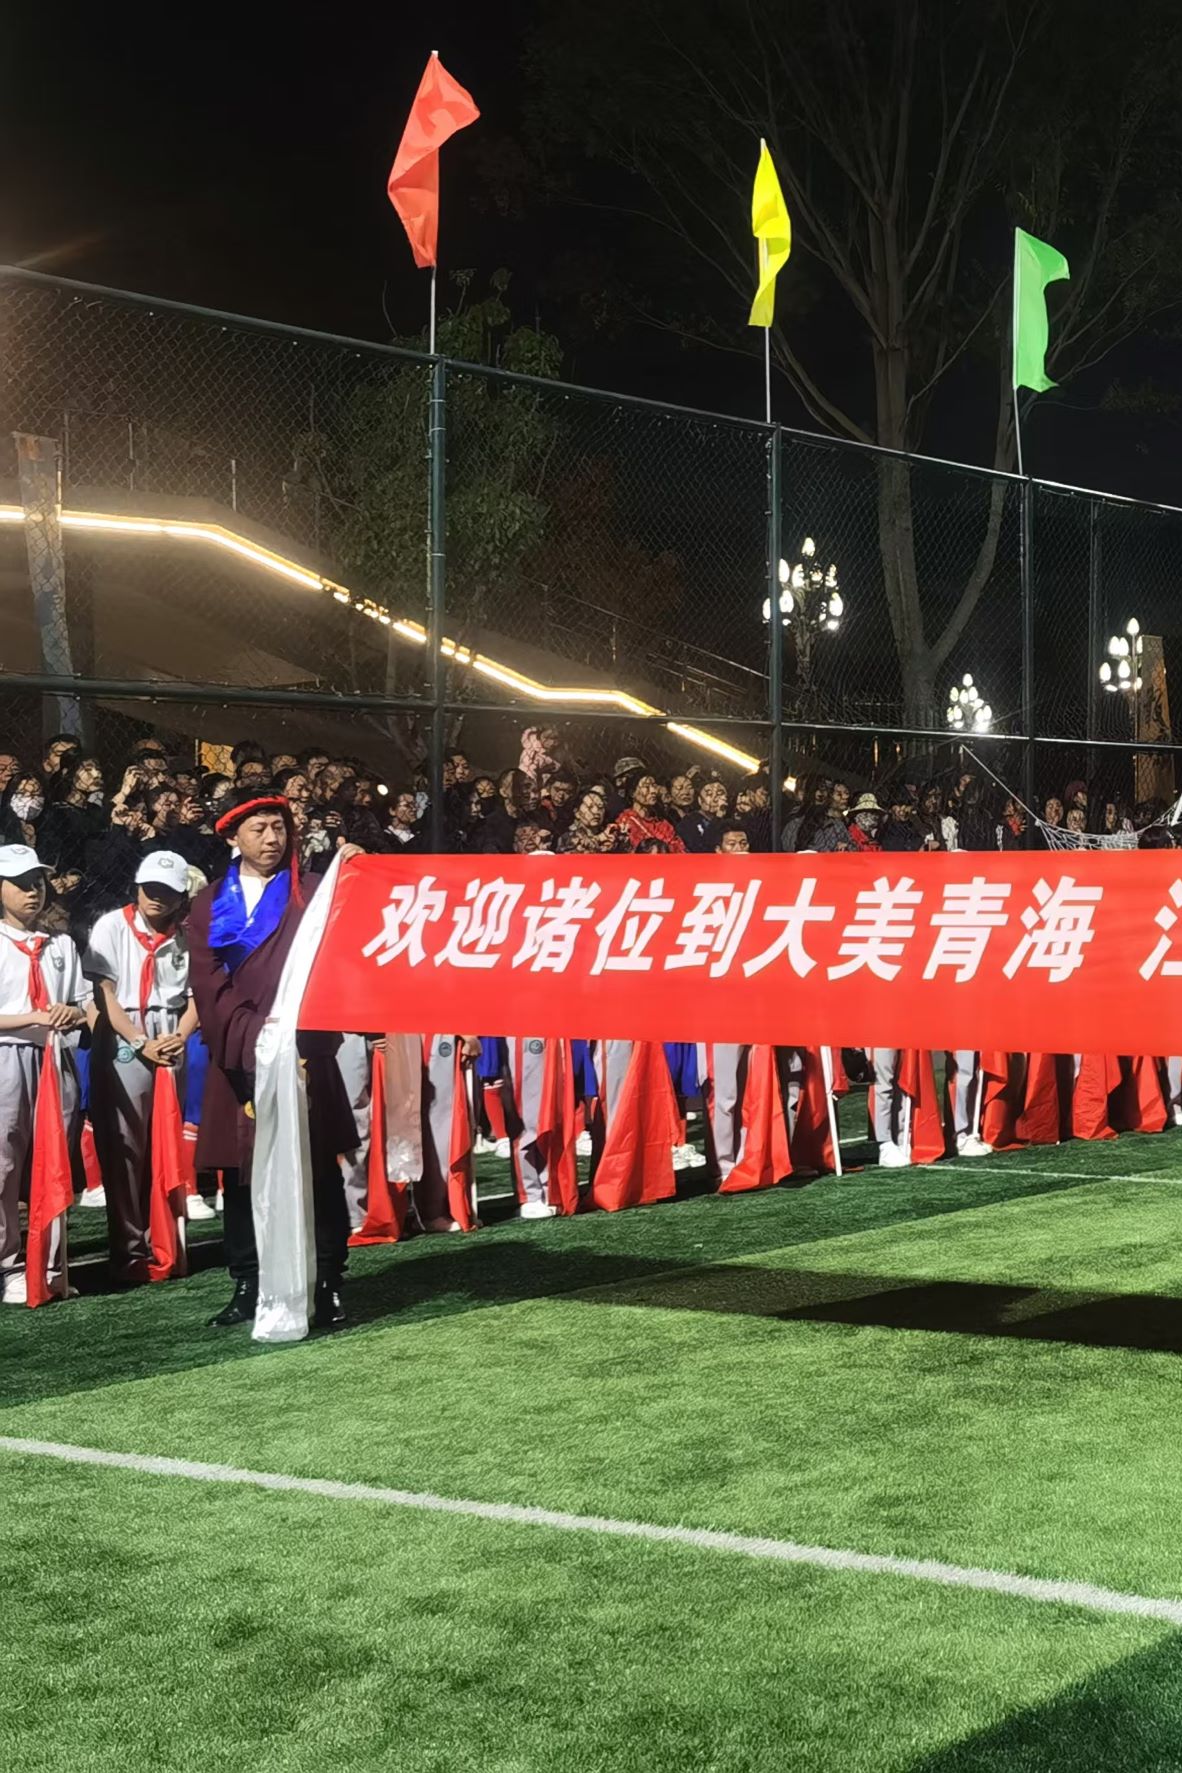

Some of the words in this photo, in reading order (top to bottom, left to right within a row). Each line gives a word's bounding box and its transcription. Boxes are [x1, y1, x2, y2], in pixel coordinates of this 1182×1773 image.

[362, 875, 1103, 983] 欢迎诸位到大美青海
